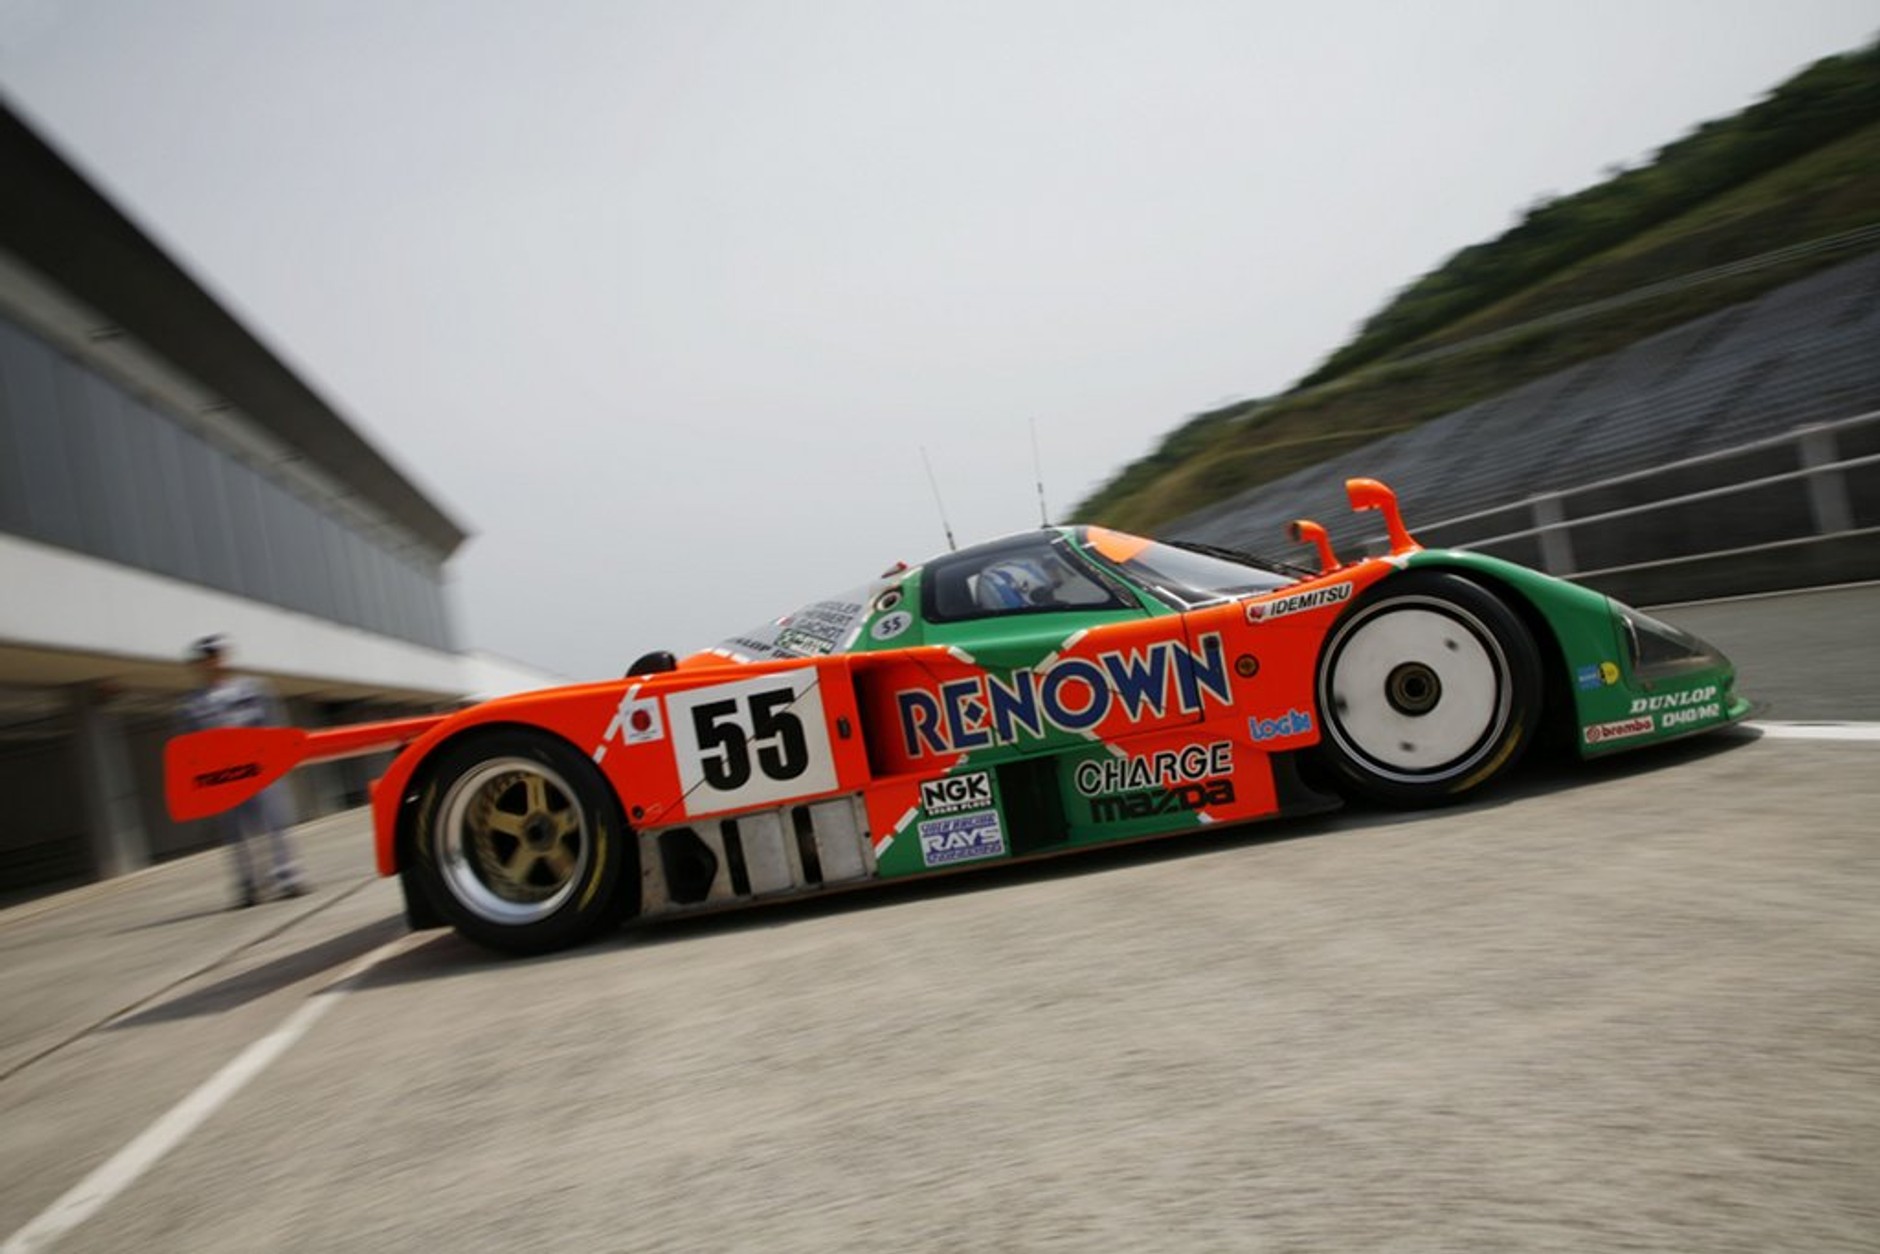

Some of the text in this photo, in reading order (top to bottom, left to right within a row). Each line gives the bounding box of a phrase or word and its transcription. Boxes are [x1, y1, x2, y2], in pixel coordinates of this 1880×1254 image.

[1271, 584, 1351, 616] IDEMITSU
[881, 615, 902, 635] 55
[896, 631, 1234, 759] RENOWN
[1629, 685, 1717, 714] DUNLOP
[691, 687, 809, 791] 55
[1601, 719, 1651, 738] brembo
[1074, 741, 1234, 797] CHARGE
[923, 774, 989, 807] NGK
[1089, 779, 1236, 824] mazda
[921, 826, 1000, 853] RAYS
